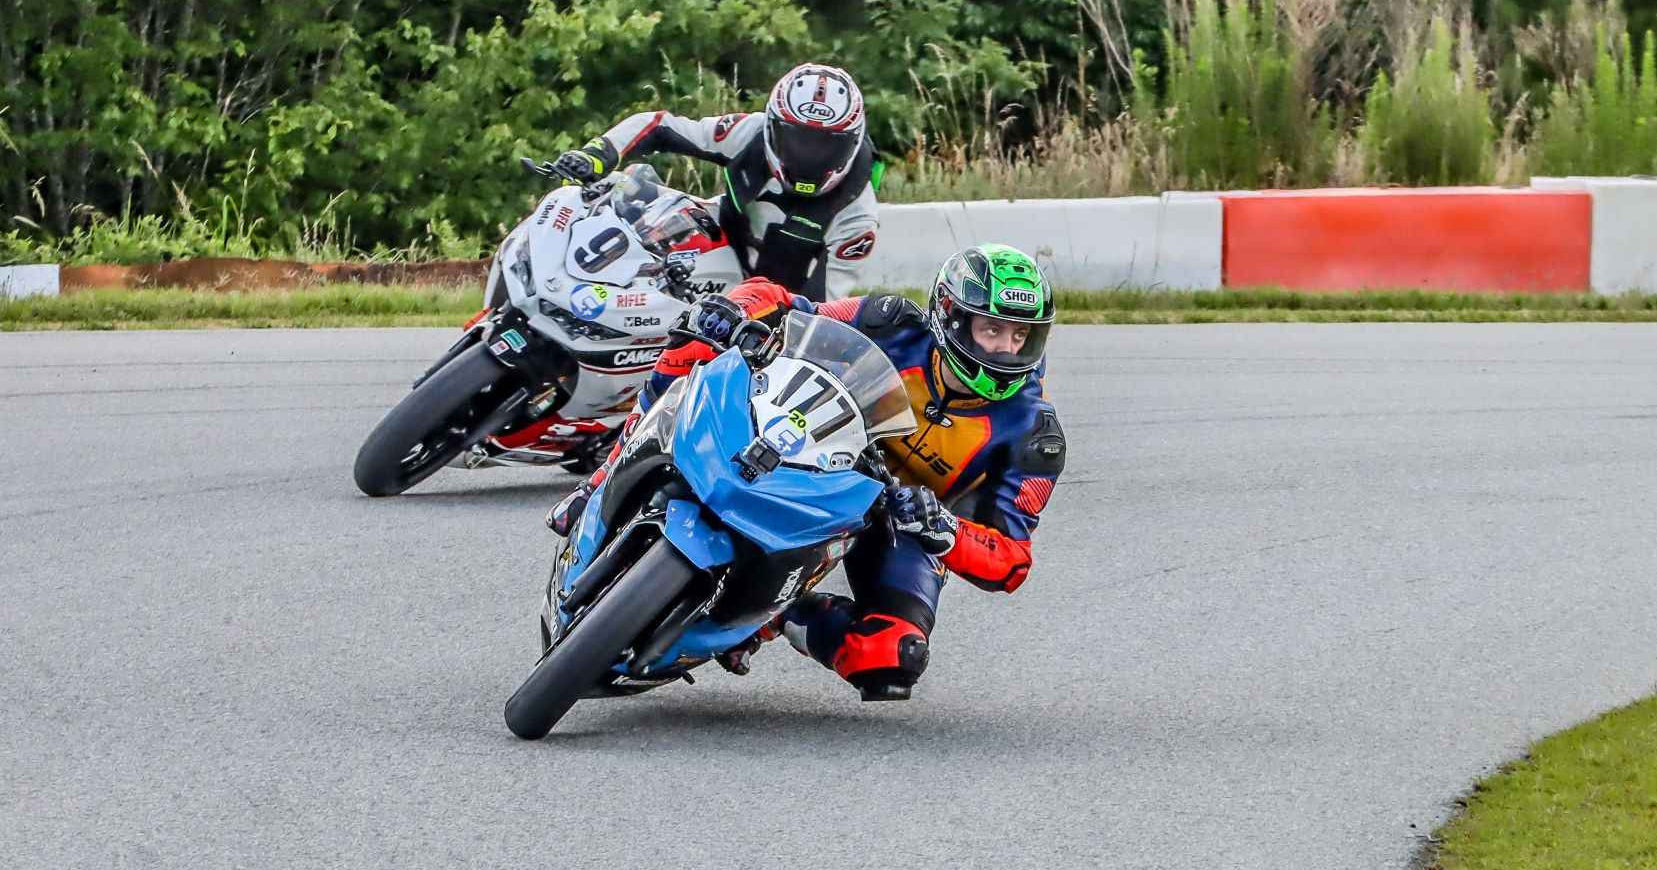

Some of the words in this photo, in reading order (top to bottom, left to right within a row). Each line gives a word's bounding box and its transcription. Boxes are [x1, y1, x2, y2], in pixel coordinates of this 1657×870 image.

[799, 103, 831, 117] Arai
[551, 206, 574, 233] RIFLE
[574, 226, 630, 274] 9
[594, 286, 608, 299] 20
[1004, 290, 1037, 304] SHOEI
[616, 293, 647, 308] RIFLE
[634, 316, 661, 327] Beta
[768, 365, 858, 444] 177
[789, 412, 807, 429] 20
